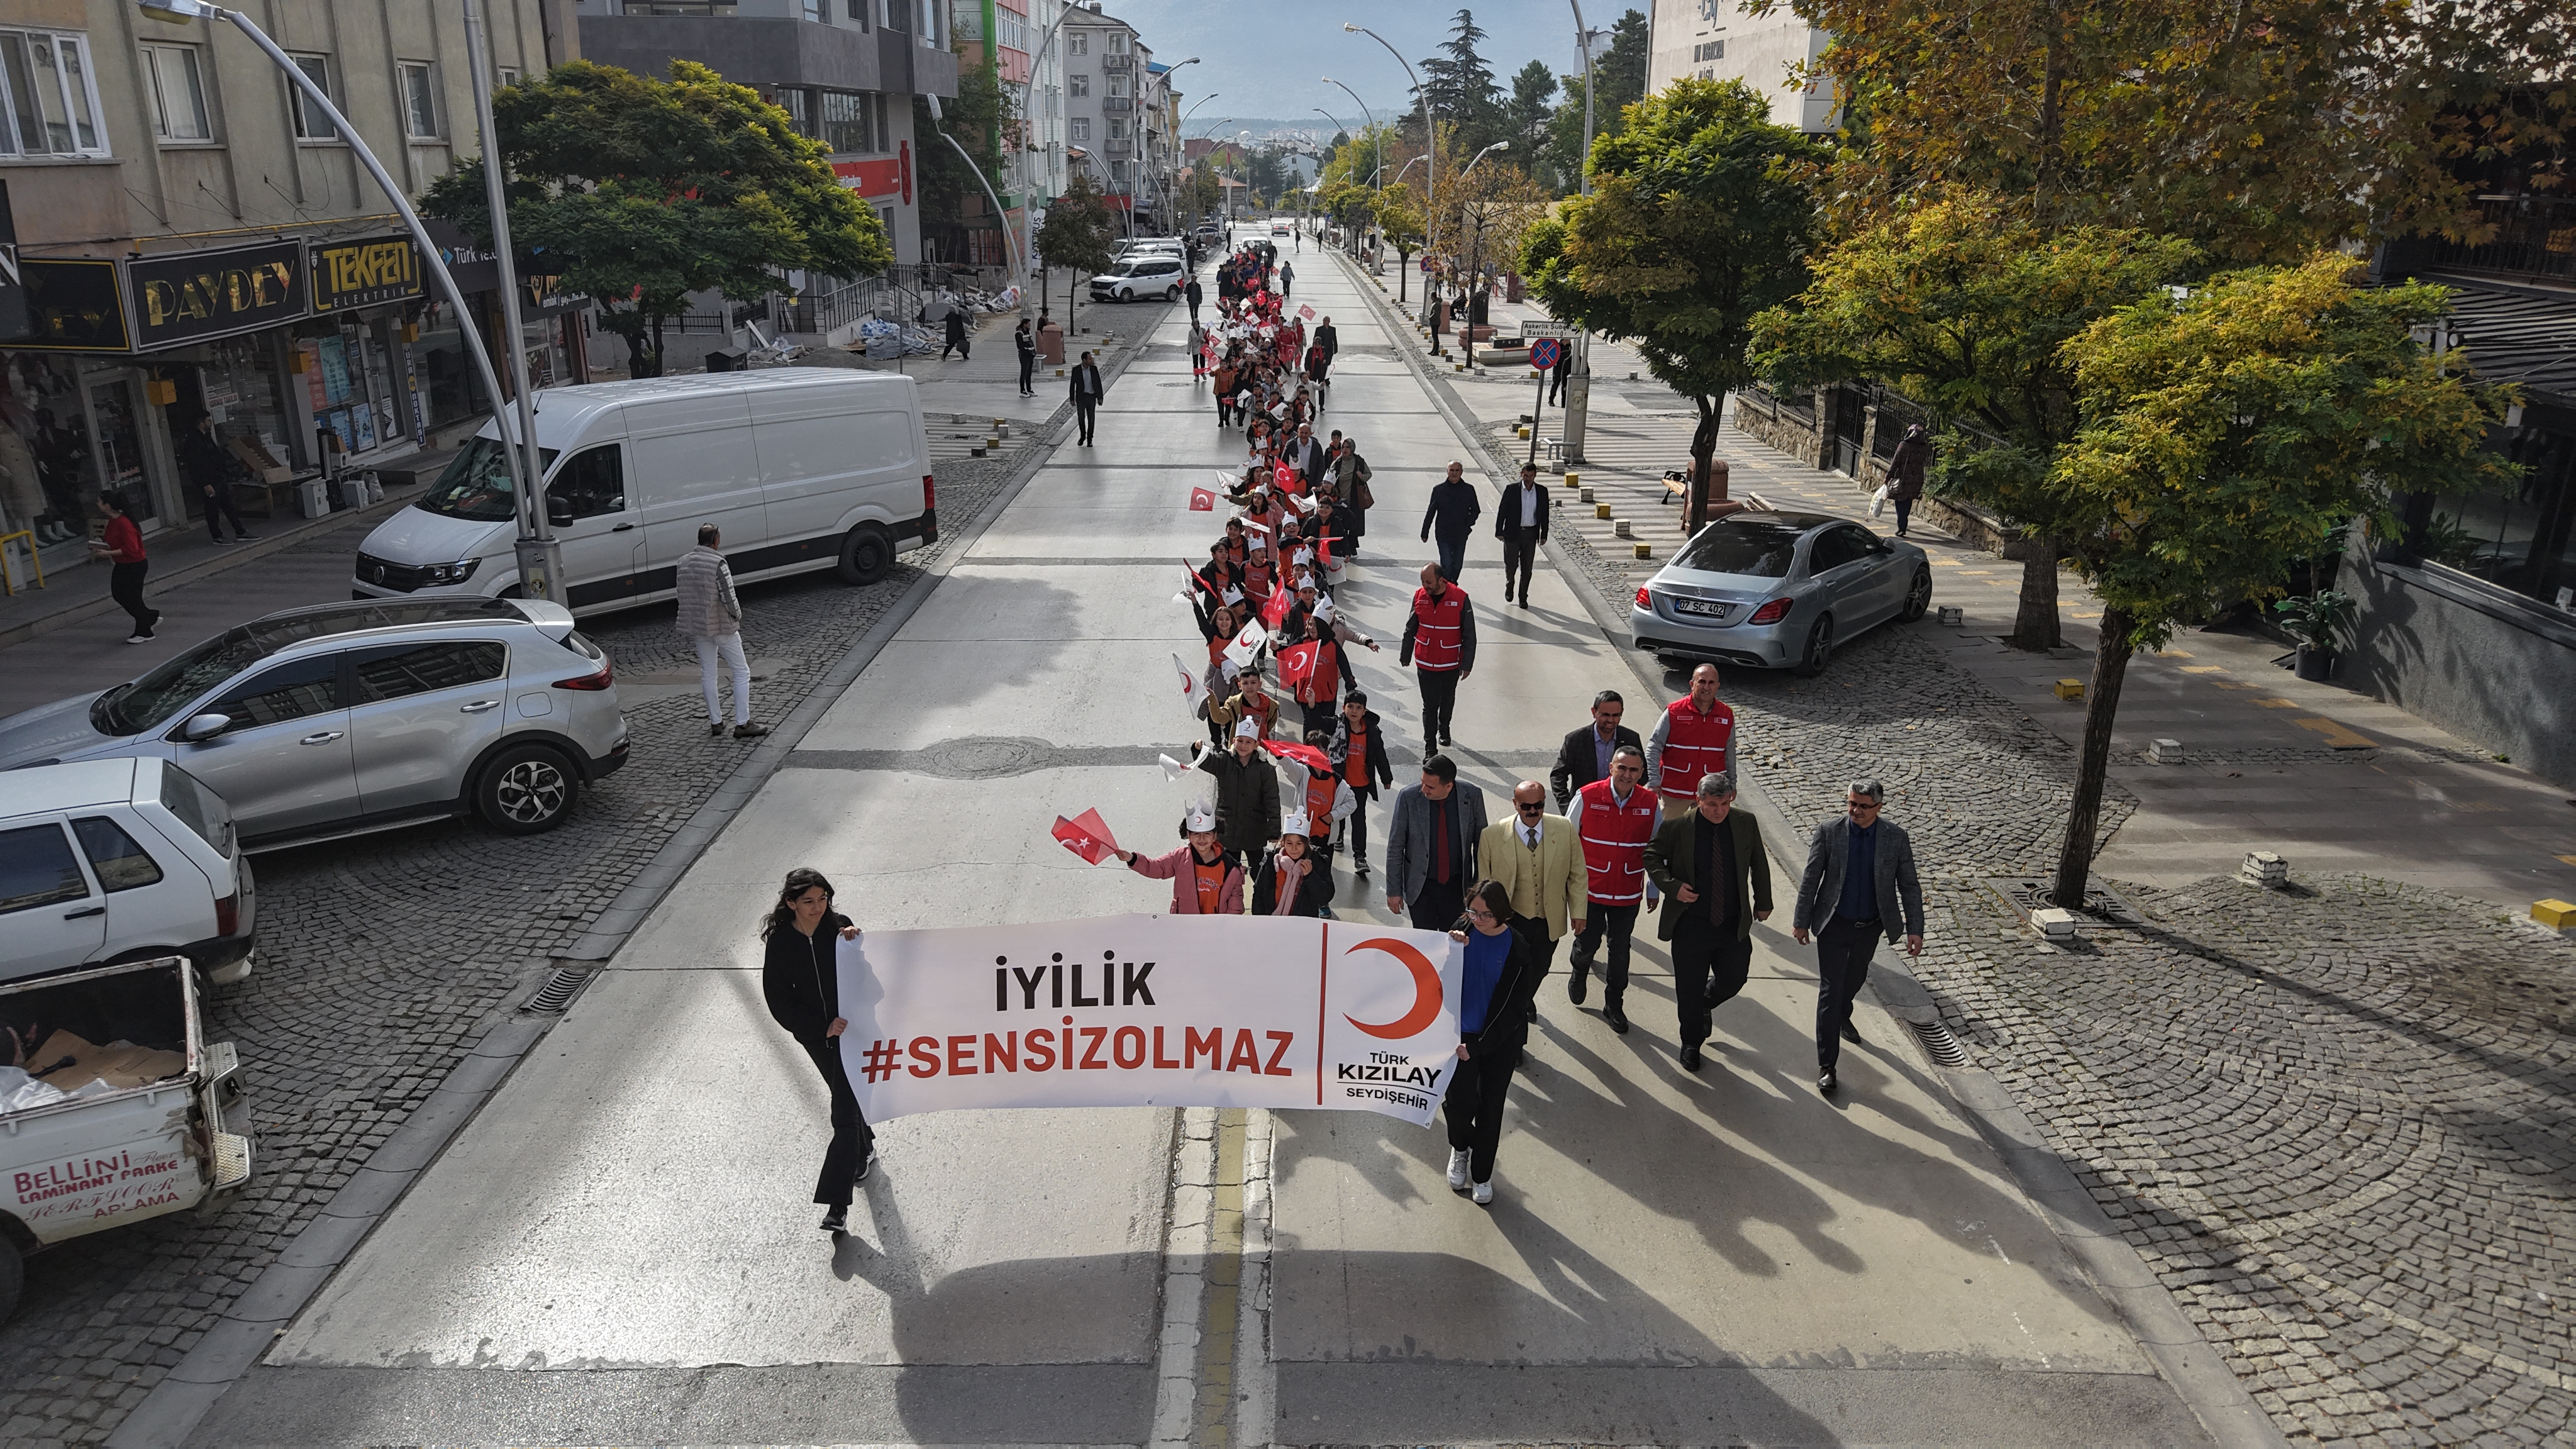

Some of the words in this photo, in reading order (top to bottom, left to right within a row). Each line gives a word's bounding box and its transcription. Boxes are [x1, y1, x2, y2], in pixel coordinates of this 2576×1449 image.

[453, 246, 477, 264] Türk
[322, 241, 411, 294] TEKFEN
[334, 287, 405, 308] ELEKTRİK
[1679, 600, 1690, 609] 07
[1692, 602, 1705, 611] SC
[1708, 604, 1723, 614] 402
[996, 950, 1156, 1012] İYİLİK
[861, 1016, 1293, 1083] #SENSİZOLMAZ
[1370, 1051, 1409, 1065] TÜRK
[1338, 1063, 1442, 1089] KIZILAY
[1346, 1087, 1428, 1111] SEYDİŞEHİR
